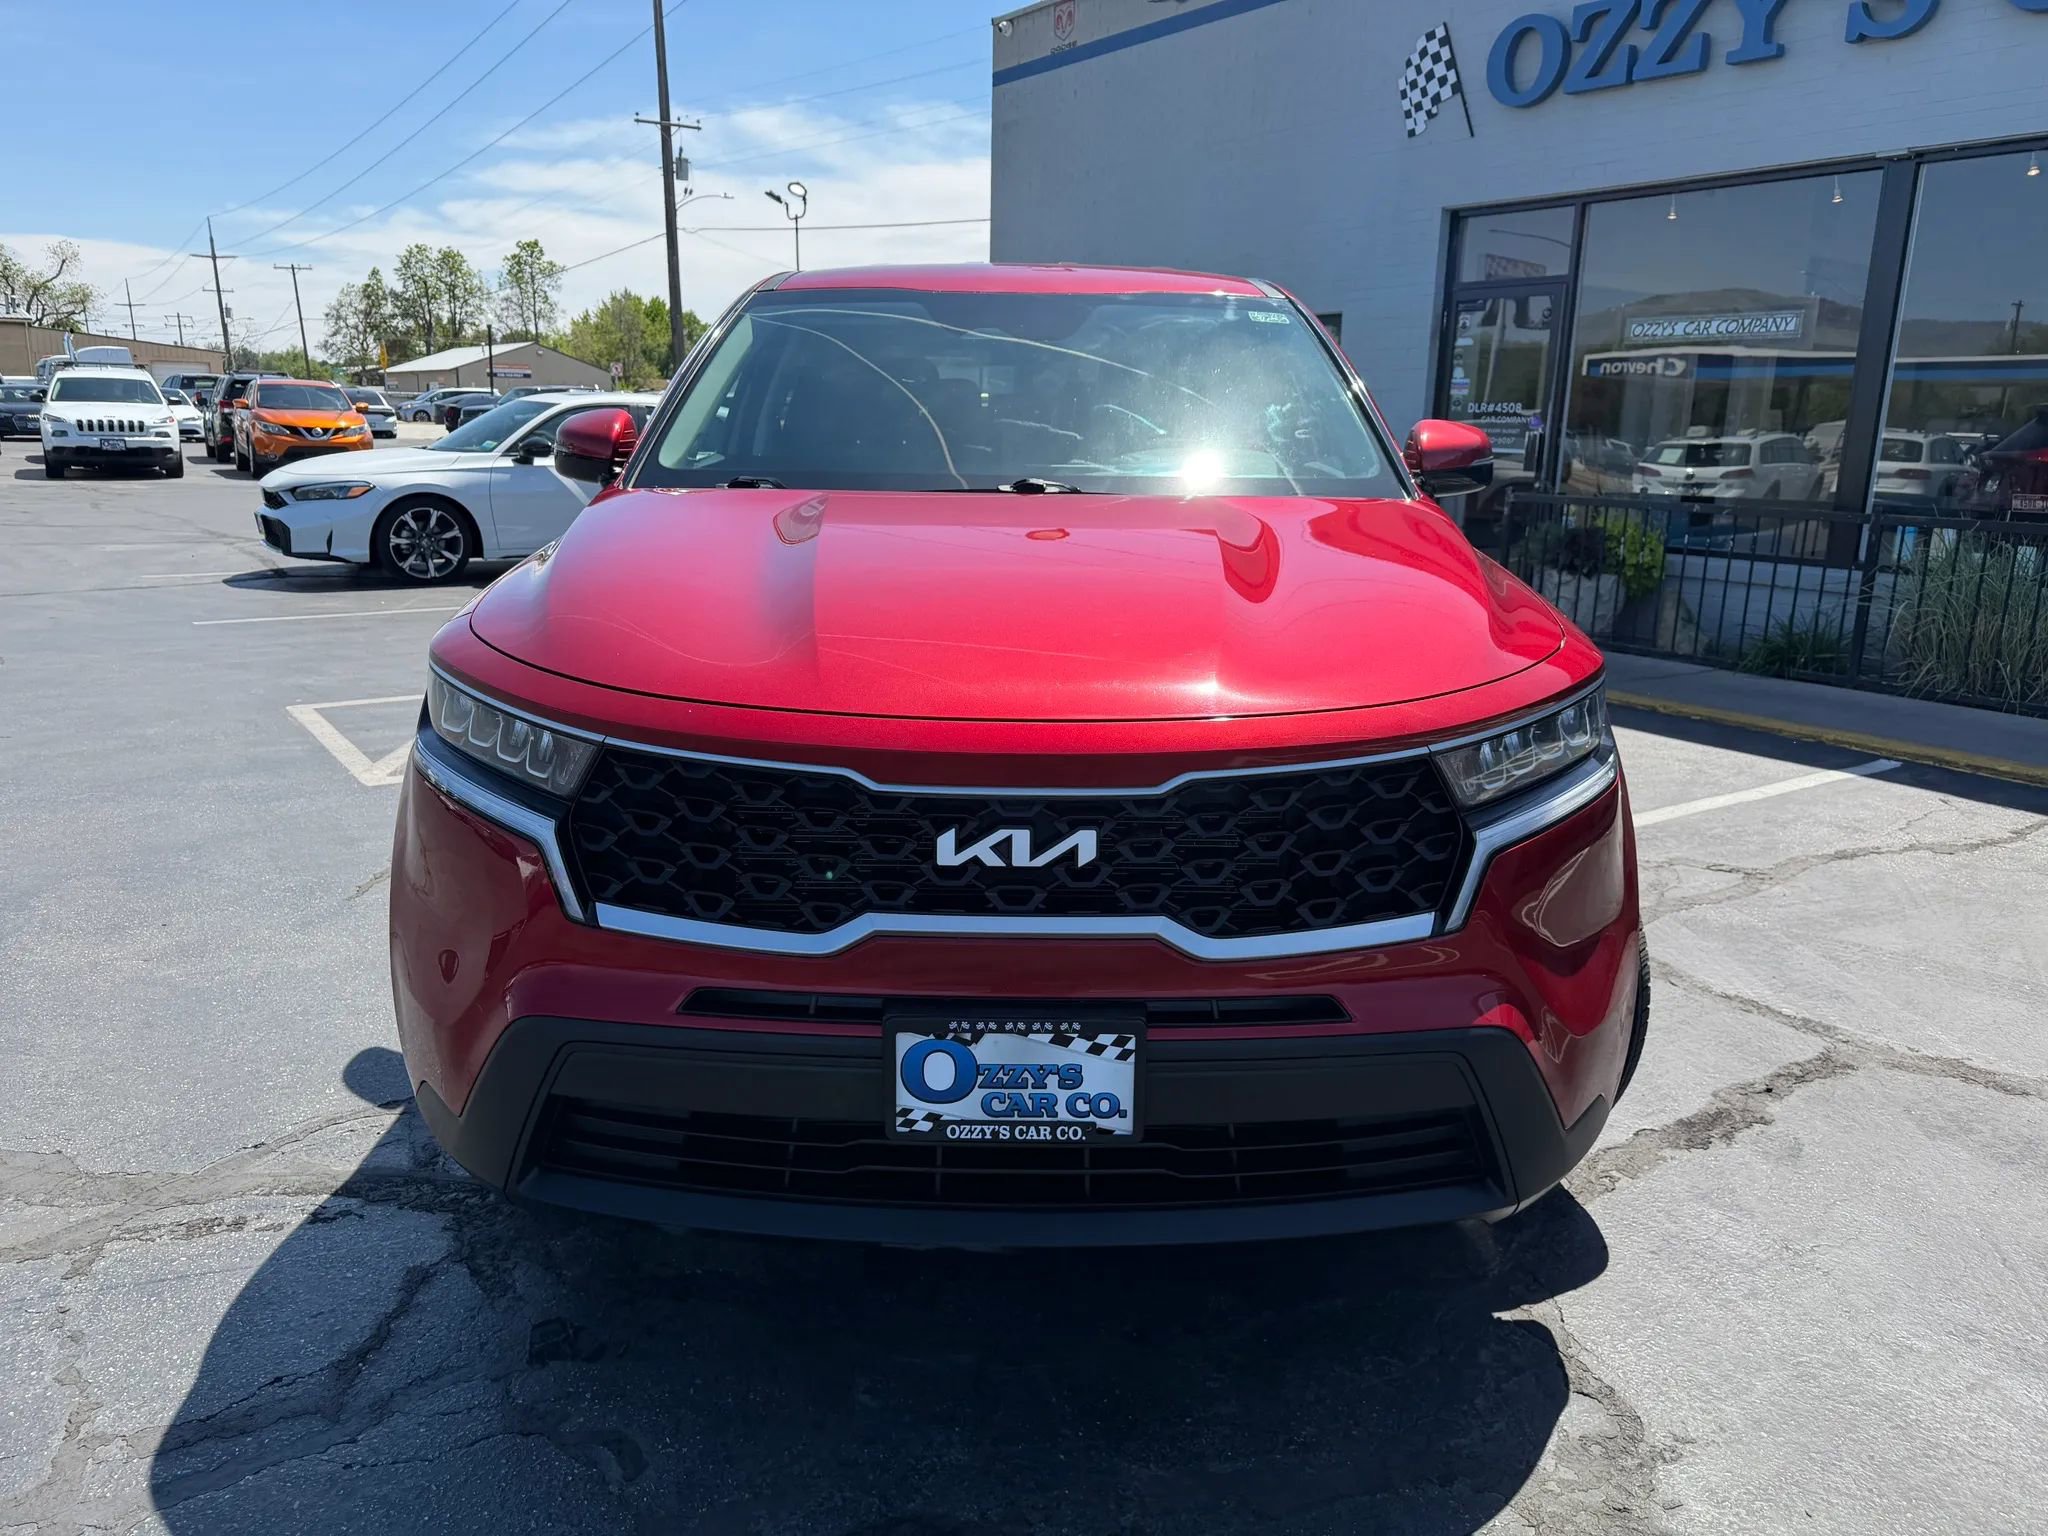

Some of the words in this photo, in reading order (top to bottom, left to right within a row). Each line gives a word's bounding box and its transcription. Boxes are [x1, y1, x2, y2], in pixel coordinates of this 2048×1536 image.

[1486, 0, 1938, 108] OZZY
[1632, 322, 1676, 338] OZZY'S
[1683, 321, 1711, 336] CAR
[1715, 316, 1794, 334] COMPANY
[1467, 402, 1522, 413] DLR#4508
[937, 827, 1097, 868] KIA
[900, 1038, 1083, 1104] OZZY'S
[981, 1092, 1058, 1118] CAR
[1065, 1092, 1128, 1118] CO.
[946, 1125, 1010, 1140] OZZY'S
[1014, 1125, 1052, 1140] CAR
[1056, 1126, 1086, 1141] CO.
